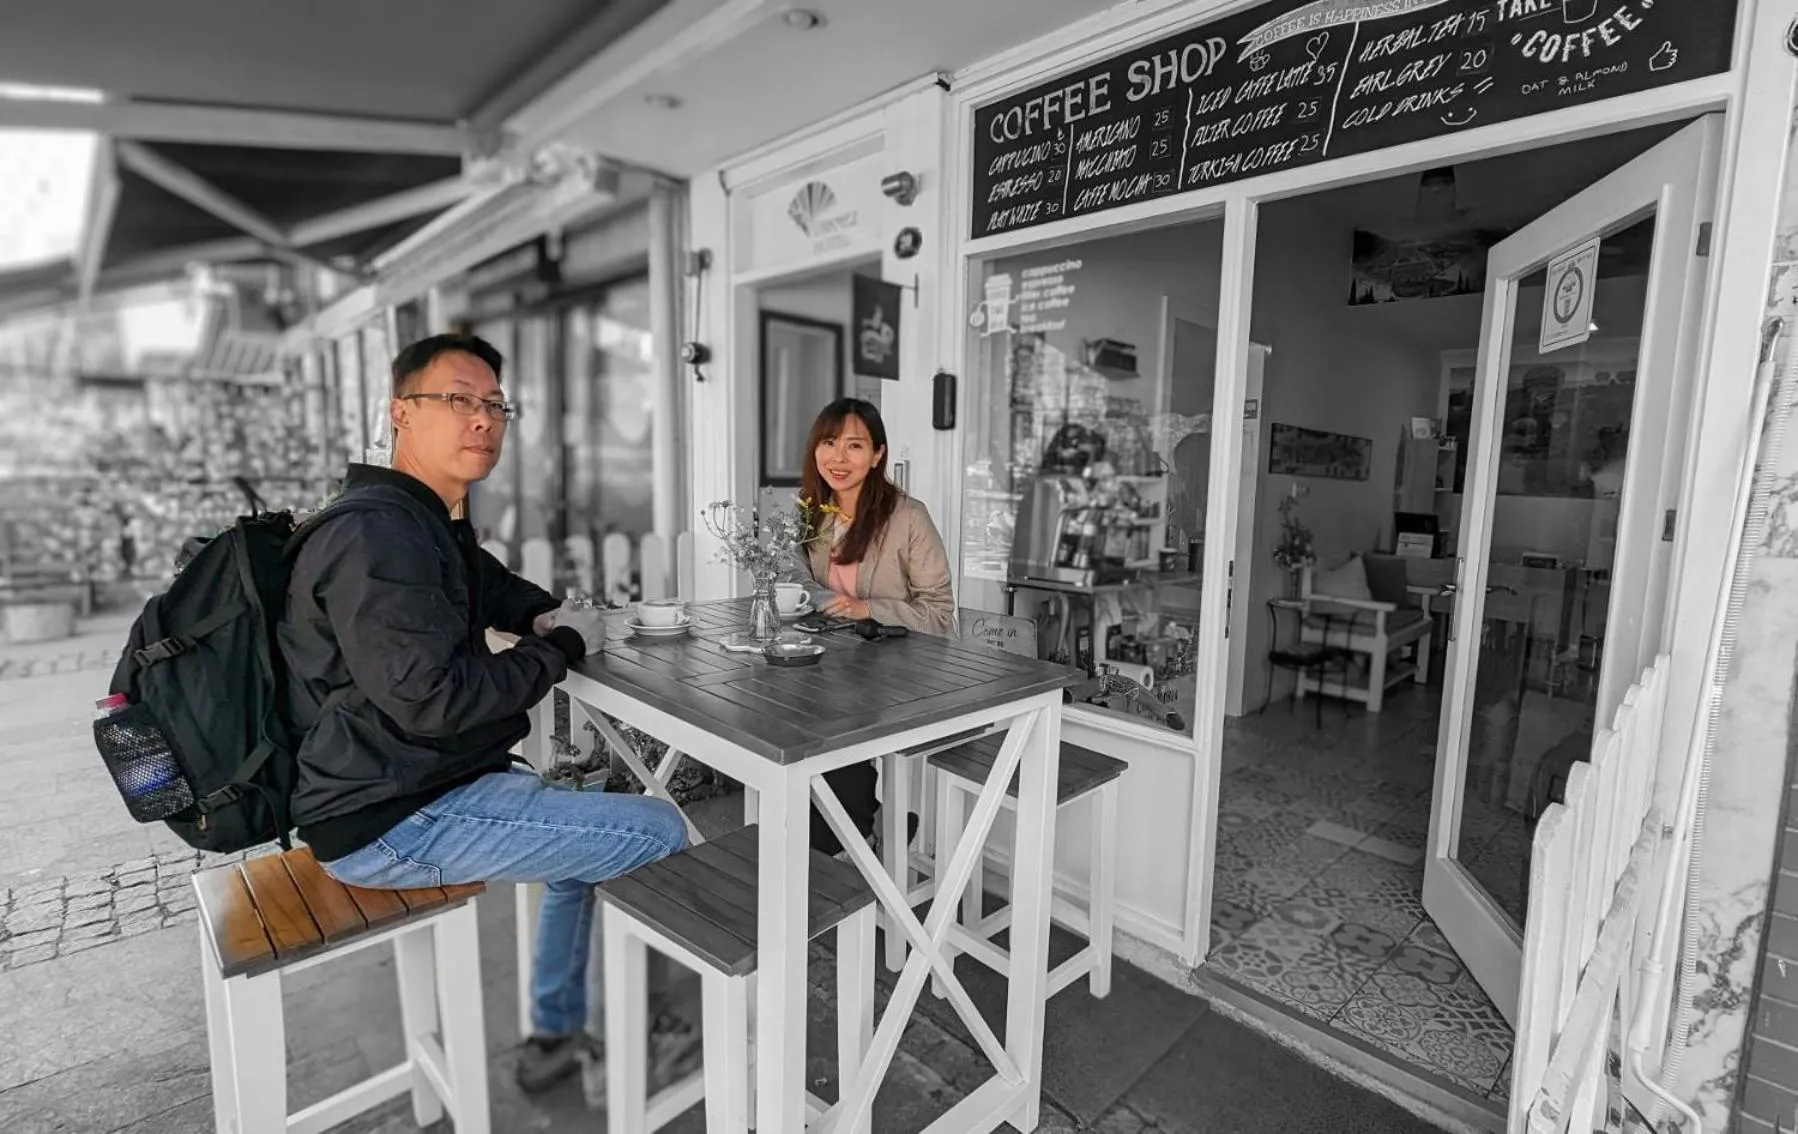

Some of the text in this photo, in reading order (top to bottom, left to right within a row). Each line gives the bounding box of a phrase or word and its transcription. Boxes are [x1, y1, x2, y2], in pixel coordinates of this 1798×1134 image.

[1255, 16, 1305, 46] COFFEE
[1309, 12, 1322, 26] IS
[1325, 0, 1400, 24] HAPPINESS
[1358, 9, 1490, 63] HERBAL TEA 15
[1521, 5, 1643, 64] COFFEE
[990, 37, 1227, 144] COFFEE SHOP
[1196, 86, 1232, 116] ICED
[1234, 71, 1279, 105] CAFFE
[1275, 60, 1317, 93] LATTE
[1350, 49, 1487, 100] EARL GREY 20
[1521, 79, 1550, 95] OAT
[1575, 61, 1629, 82] ALMOND
[1558, 81, 1596, 96] MILK
[1190, 101, 1319, 149] FILTER COFFEE 25
[1342, 82, 1466, 129] COLD DRINKS
[1075, 114, 1141, 154] AMERICANO
[1154, 109, 1170, 127] 25
[988, 140, 1067, 177] CAPPUCINO 30
[1075, 138, 1168, 181] MACCHIATO 25
[1187, 133, 1321, 185] TURKISH COFFEE 25
[987, 169, 1062, 204] ESPRESSO 20
[1073, 172, 1171, 212] CAFFE MOCHA 30
[1008, 199, 1043, 227] WHITE
[1045, 201, 1060, 216] 30
